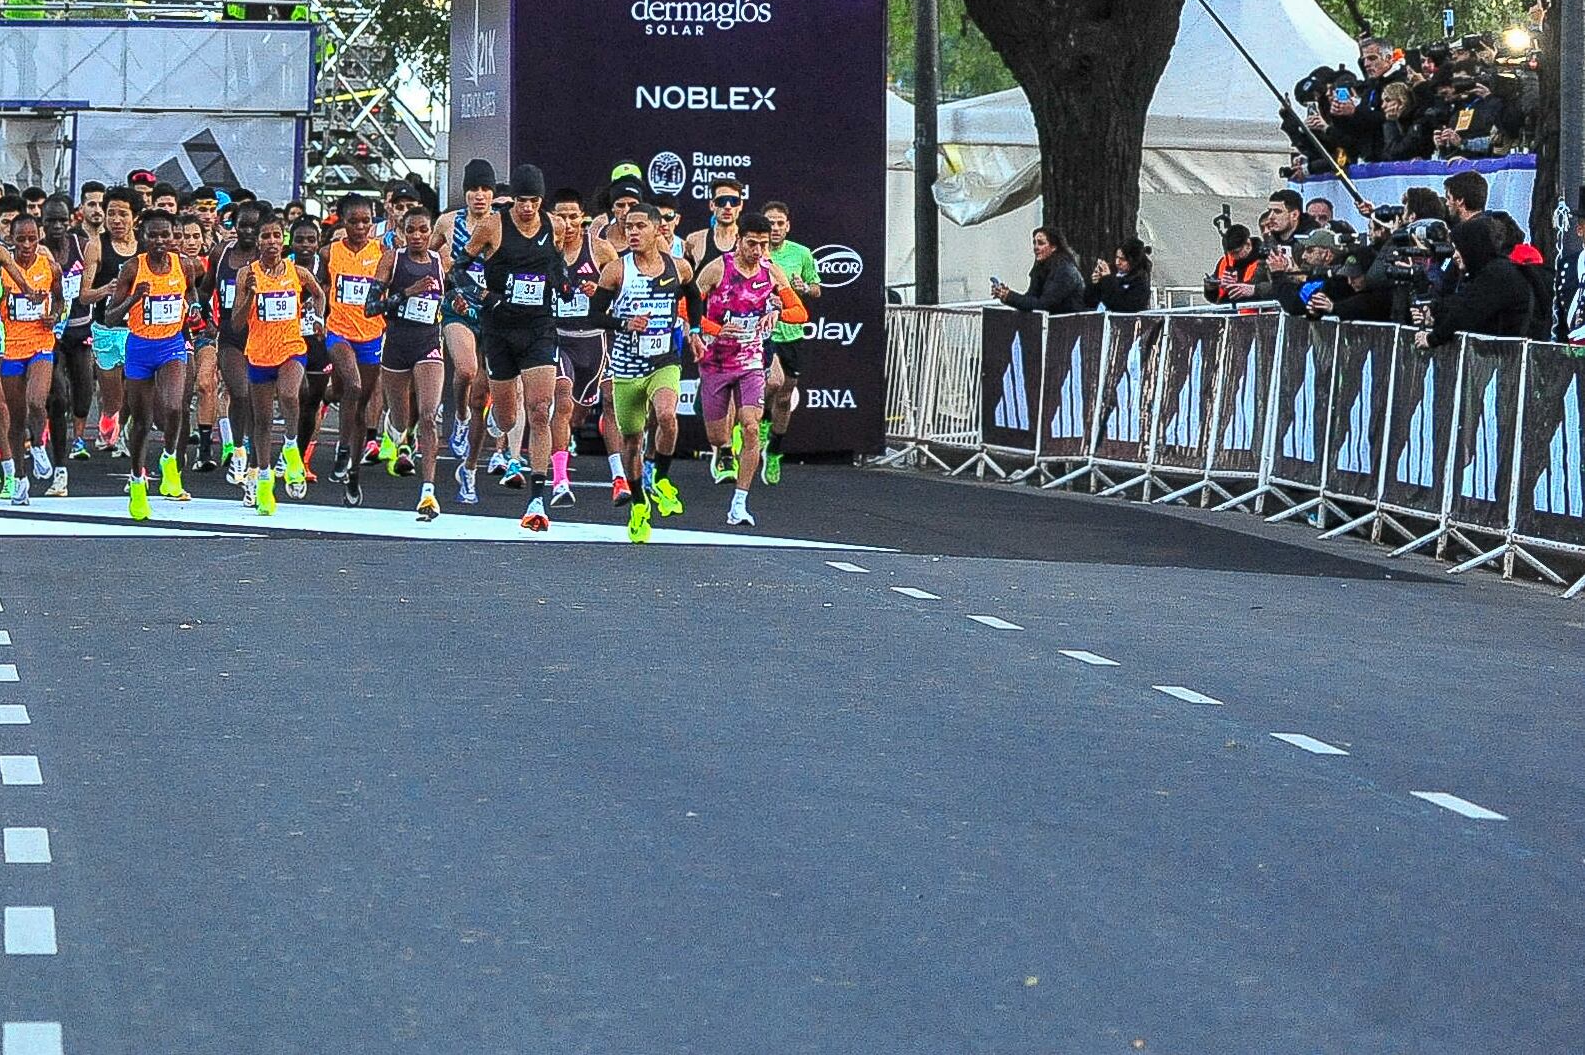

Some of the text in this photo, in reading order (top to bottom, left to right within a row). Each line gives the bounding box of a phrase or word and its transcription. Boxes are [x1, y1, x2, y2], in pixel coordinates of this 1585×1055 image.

[645, 24, 705, 36] SOLAR
[635, 85, 776, 111] NOBLEX
[692, 151, 752, 167] Buenos
[691, 168, 736, 183] Aires
[353, 285, 364, 296] 64
[523, 284, 536, 295] 33
[163, 304, 172, 314] 51
[276, 300, 287, 311] 58
[416, 301, 429, 312] 53
[650, 338, 662, 349] 20
[806, 390, 858, 409] BNA
